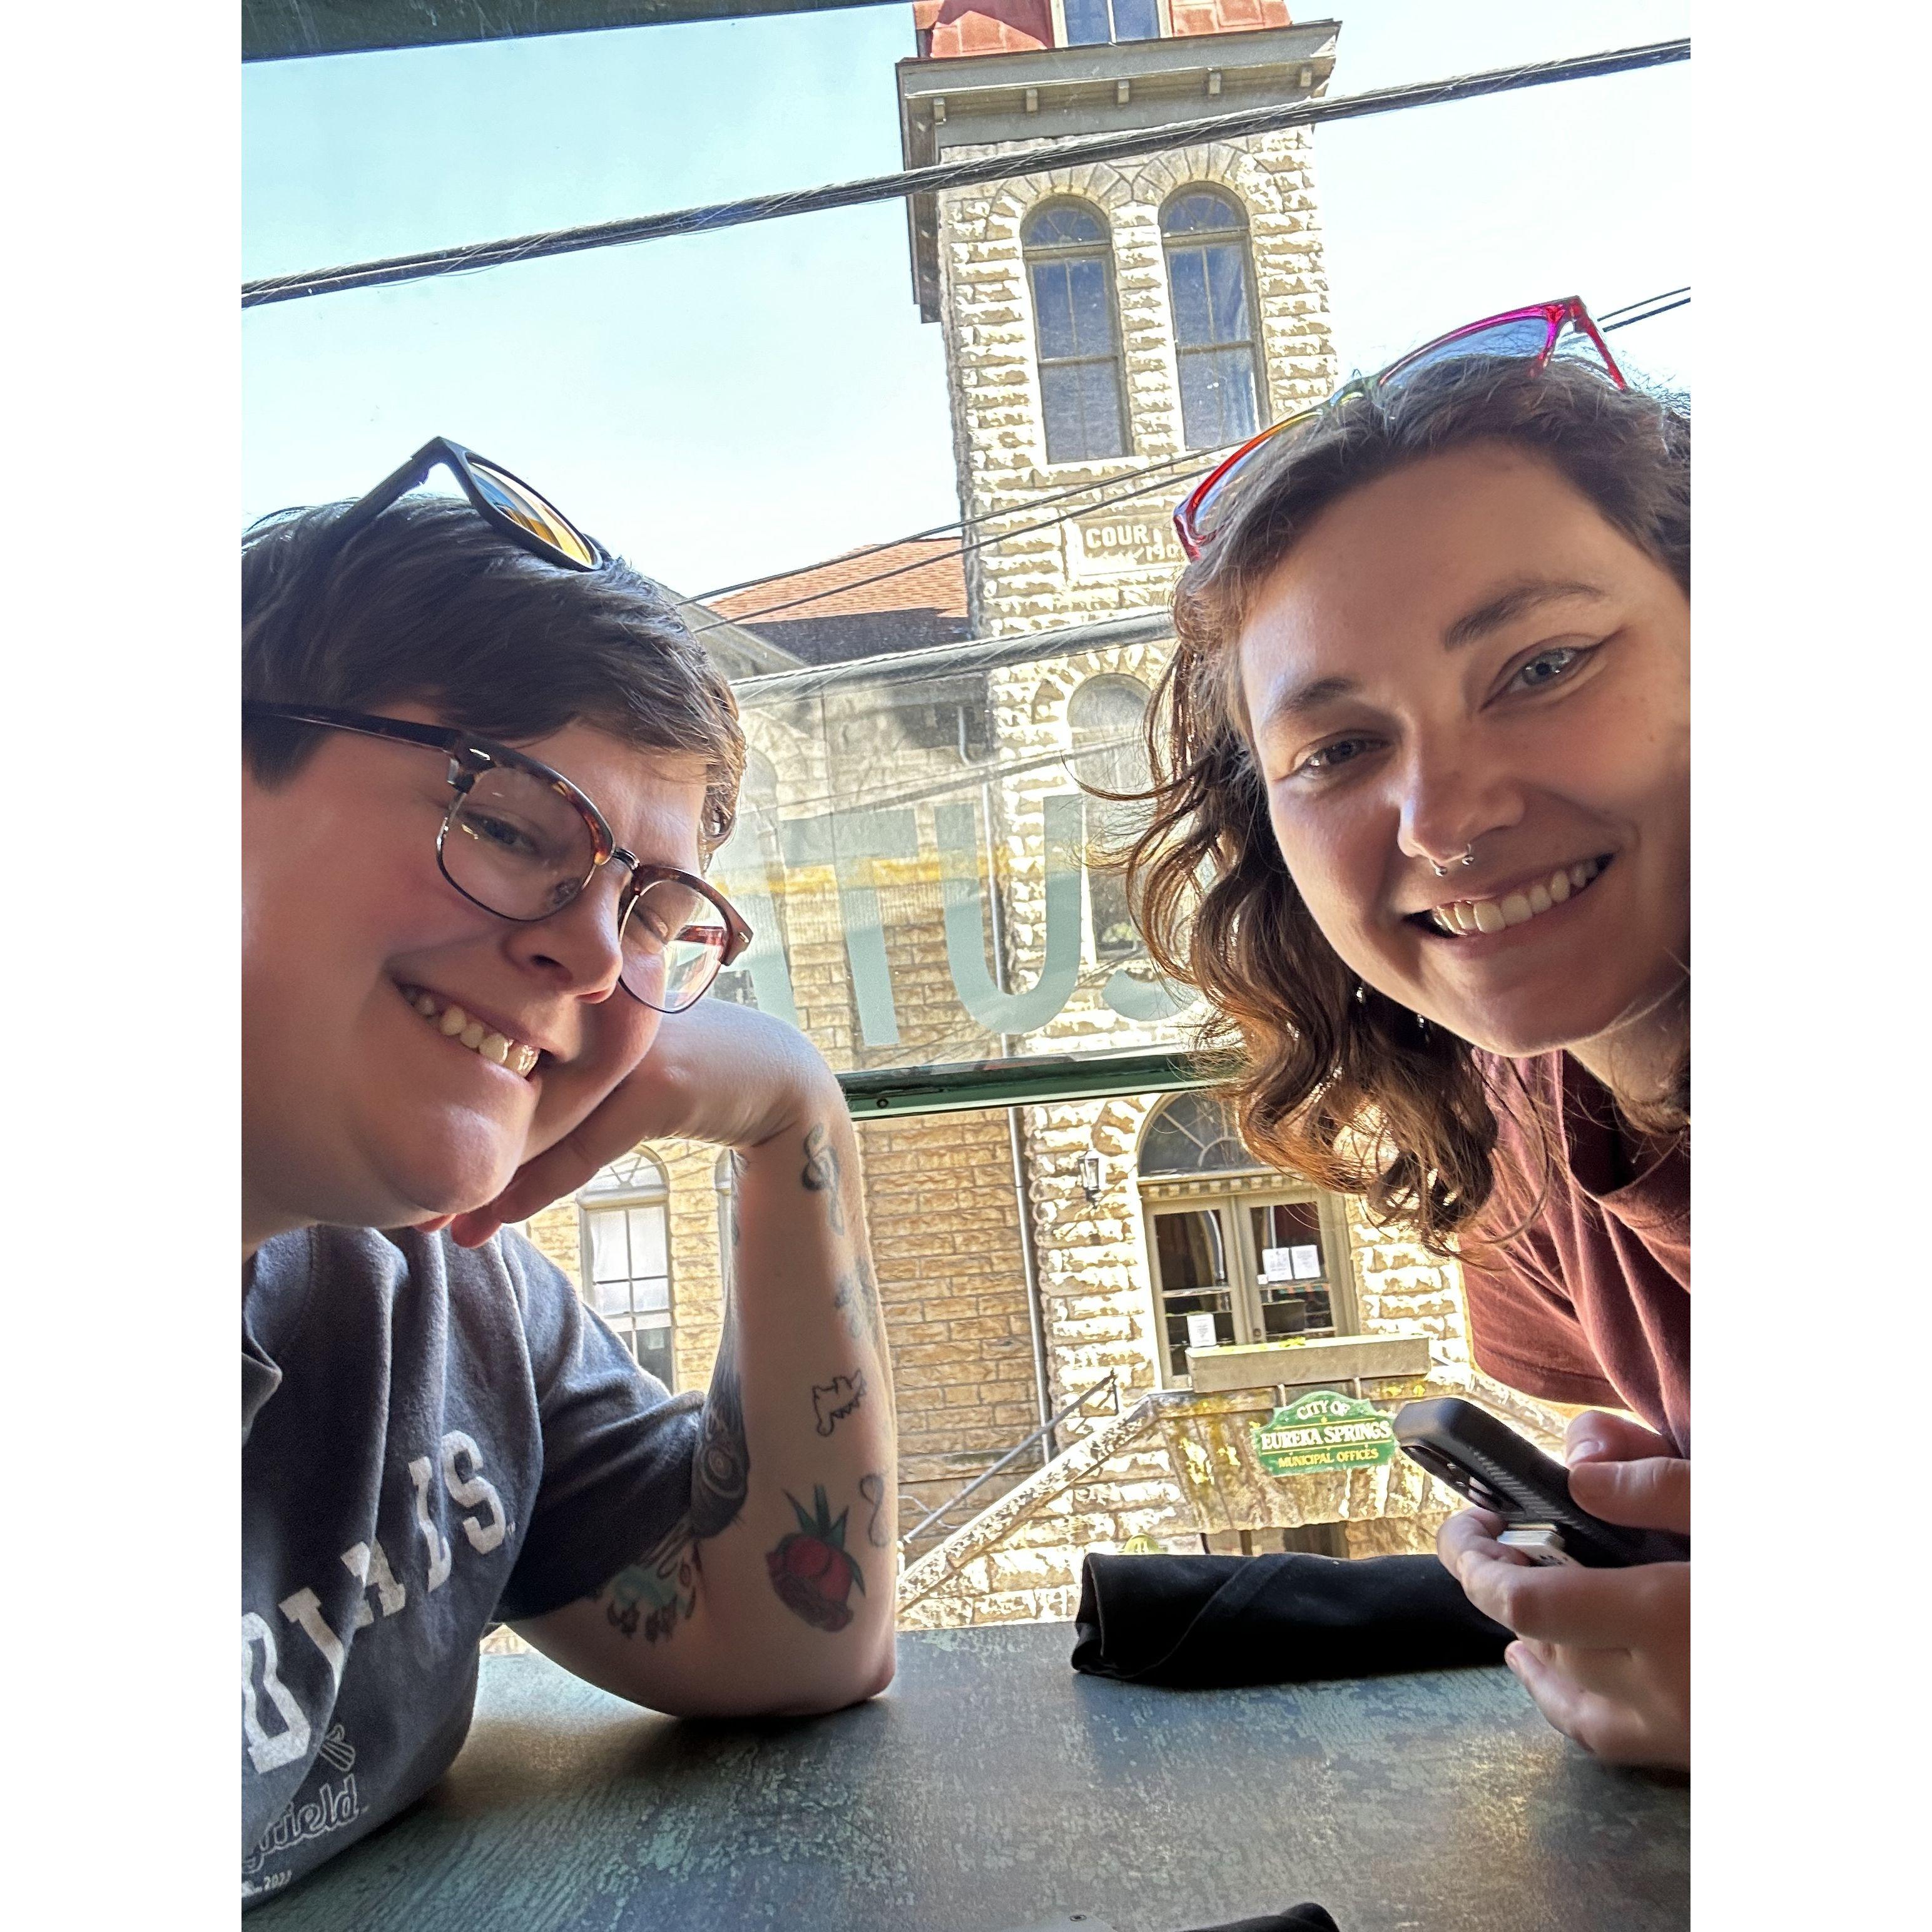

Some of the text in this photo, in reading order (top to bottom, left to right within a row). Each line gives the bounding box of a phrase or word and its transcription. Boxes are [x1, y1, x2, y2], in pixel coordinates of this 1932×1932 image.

[1297, 1400, 1351, 1420] CITY OF
[1260, 1420, 1393, 1450] EUREKA SPRINGS
[1278, 1448, 1379, 1468] MUNICIPAL OFFICES
